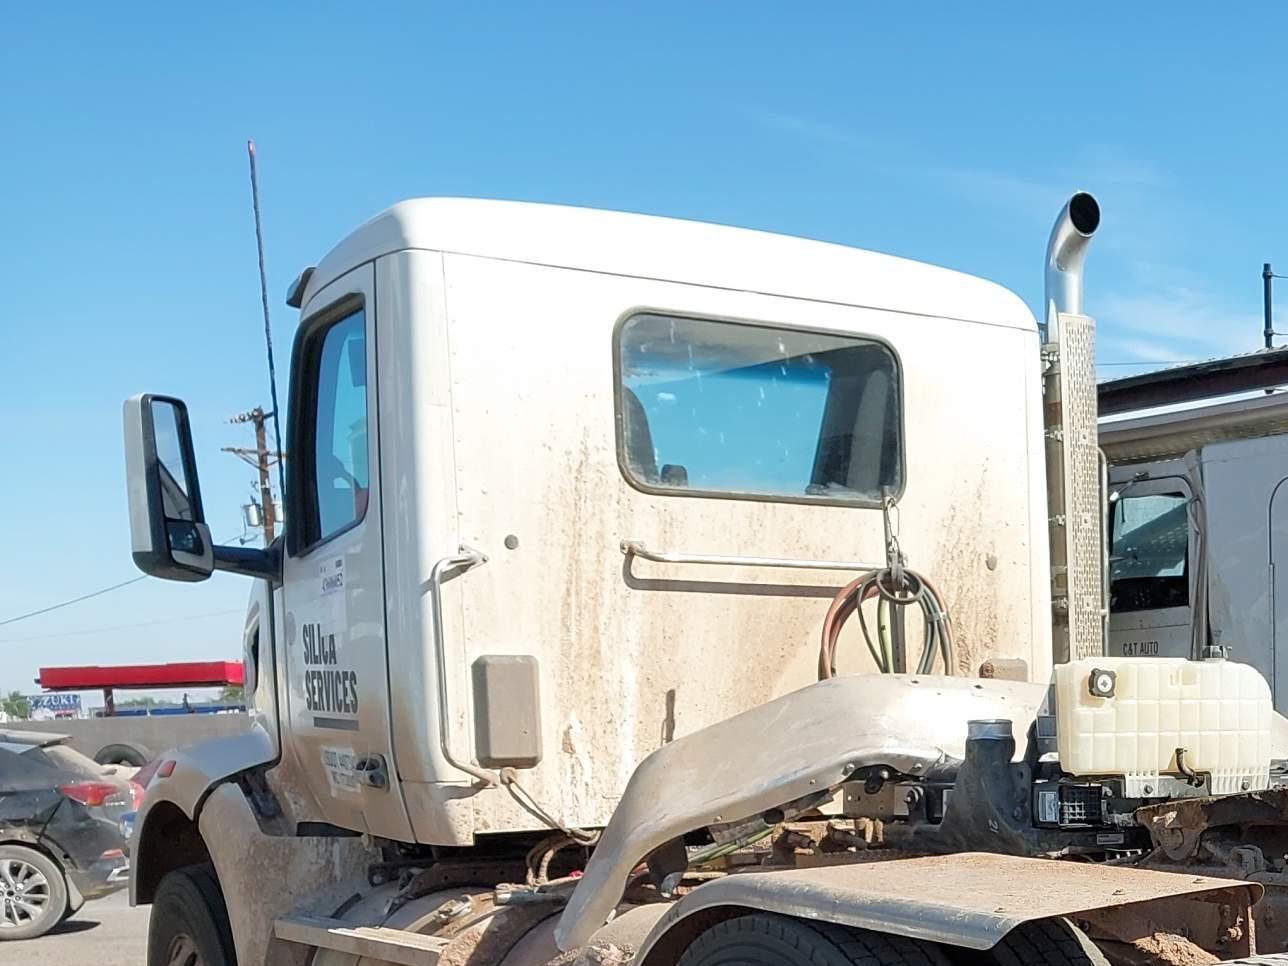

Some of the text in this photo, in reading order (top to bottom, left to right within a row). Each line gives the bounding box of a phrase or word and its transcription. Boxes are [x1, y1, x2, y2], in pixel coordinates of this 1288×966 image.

[302, 623, 337, 665] SILICA
[1122, 641, 1159, 656] C&T AUTO
[304, 670, 359, 714] SERVICES
